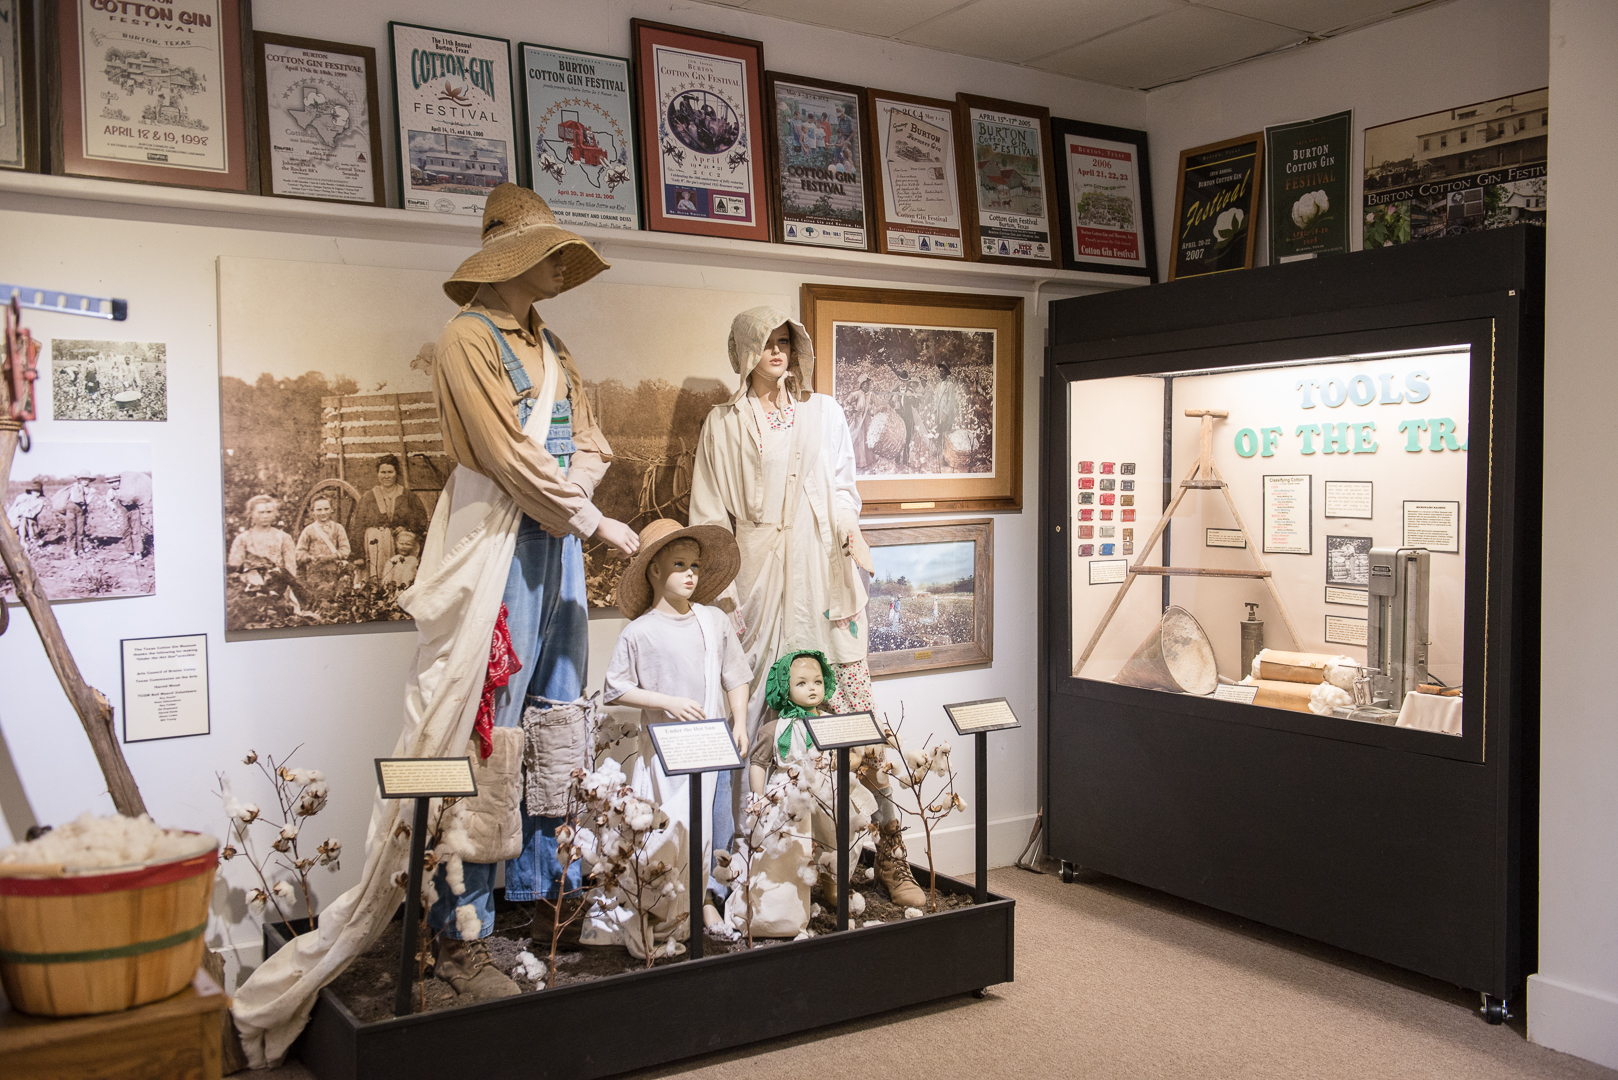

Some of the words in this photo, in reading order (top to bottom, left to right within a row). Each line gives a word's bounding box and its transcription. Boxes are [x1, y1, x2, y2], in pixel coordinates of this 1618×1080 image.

[90, 0, 173, 21] COTTON
[178, 11, 212, 27] GIN
[109, 15, 195, 34] FESTIVAL
[122, 32, 161, 45] BURTON,
[442, 38, 454, 46] 11th
[455, 40, 472, 49] Annual
[302, 51, 328, 60] BURTON
[435, 44, 455, 53] Burton,
[455, 46, 470, 54] Texas
[266, 53, 305, 65] COTTON
[306, 60, 323, 69] GIN
[324, 62, 363, 74] FESTIVAL
[284, 64, 299, 73] April
[334, 70, 348, 78] 1999
[558, 60, 595, 75] BURTON
[687, 63, 714, 73] BURTON
[411, 48, 465, 90] COTTON
[469, 56, 495, 102] GIN
[529, 68, 565, 83] COTTON
[567, 74, 583, 86] GIN
[585, 77, 625, 92] FESTIVAL
[660, 66, 690, 78] COTTON
[691, 70, 706, 81] GIN
[708, 74, 741, 87] FESTIVAL
[413, 102, 498, 123] FESTIVAL
[925, 113, 935, 121] May
[978, 113, 996, 121] APRIL
[1018, 119, 1031, 127] 2005
[103, 125, 135, 138] APRIL
[137, 129, 151, 140] 18
[152, 131, 161, 141] &
[164, 131, 179, 144] 19,
[181, 133, 209, 146] 1998
[910, 122, 941, 144] BURTON
[978, 122, 1027, 141] BURTON
[907, 132, 930, 147] Farmers
[978, 136, 1007, 144] Cotton
[1011, 137, 1027, 148] Gin
[930, 142, 942, 153] Gin
[992, 143, 1036, 157] FESTIVAL
[1078, 146, 1104, 156] BURTON,
[1107, 150, 1125, 158] TEXAS
[1292, 144, 1329, 161] BURTON
[693, 155, 720, 164] April
[1092, 158, 1112, 169] 2006
[1286, 160, 1317, 174] COTTON
[1320, 156, 1335, 168] GIN
[787, 164, 833, 182] COTTON
[835, 171, 857, 184] GIN
[1077, 167, 1095, 177] April
[1096, 170, 1107, 179] 21,
[1108, 171, 1119, 181] 22,
[1119, 173, 1129, 181] 23
[1219, 167, 1233, 175] ANNUAL
[800, 179, 846, 196] FESTIVAL
[1198, 179, 1215, 188] BURTON
[1216, 175, 1233, 184] COTTON
[1233, 172, 1242, 181] GIN
[1285, 169, 1336, 191] FESTIVAL
[1367, 188, 1413, 206] BURTON
[1419, 179, 1471, 196] COTTON
[1476, 173, 1501, 187] GIN
[1182, 168, 1251, 239] Festival
[896, 211, 916, 219] Cotton
[927, 214, 948, 223] Festival
[989, 214, 1007, 222] Cotton
[1019, 217, 1038, 225] Festival
[1292, 230, 1309, 238] APRIL
[1303, 236, 1318, 246] 2008
[1182, 240, 1197, 249] APRIL
[1198, 238, 1211, 247] 20-22
[1081, 244, 1101, 256] Cotton
[1101, 246, 1112, 257] Gin
[1113, 249, 1136, 259] Festival
[1185, 248, 1205, 261] 2007
[1295, 370, 1431, 410] TOOLS
[1234, 426, 1283, 458] OF
[1295, 420, 1379, 455] THE
